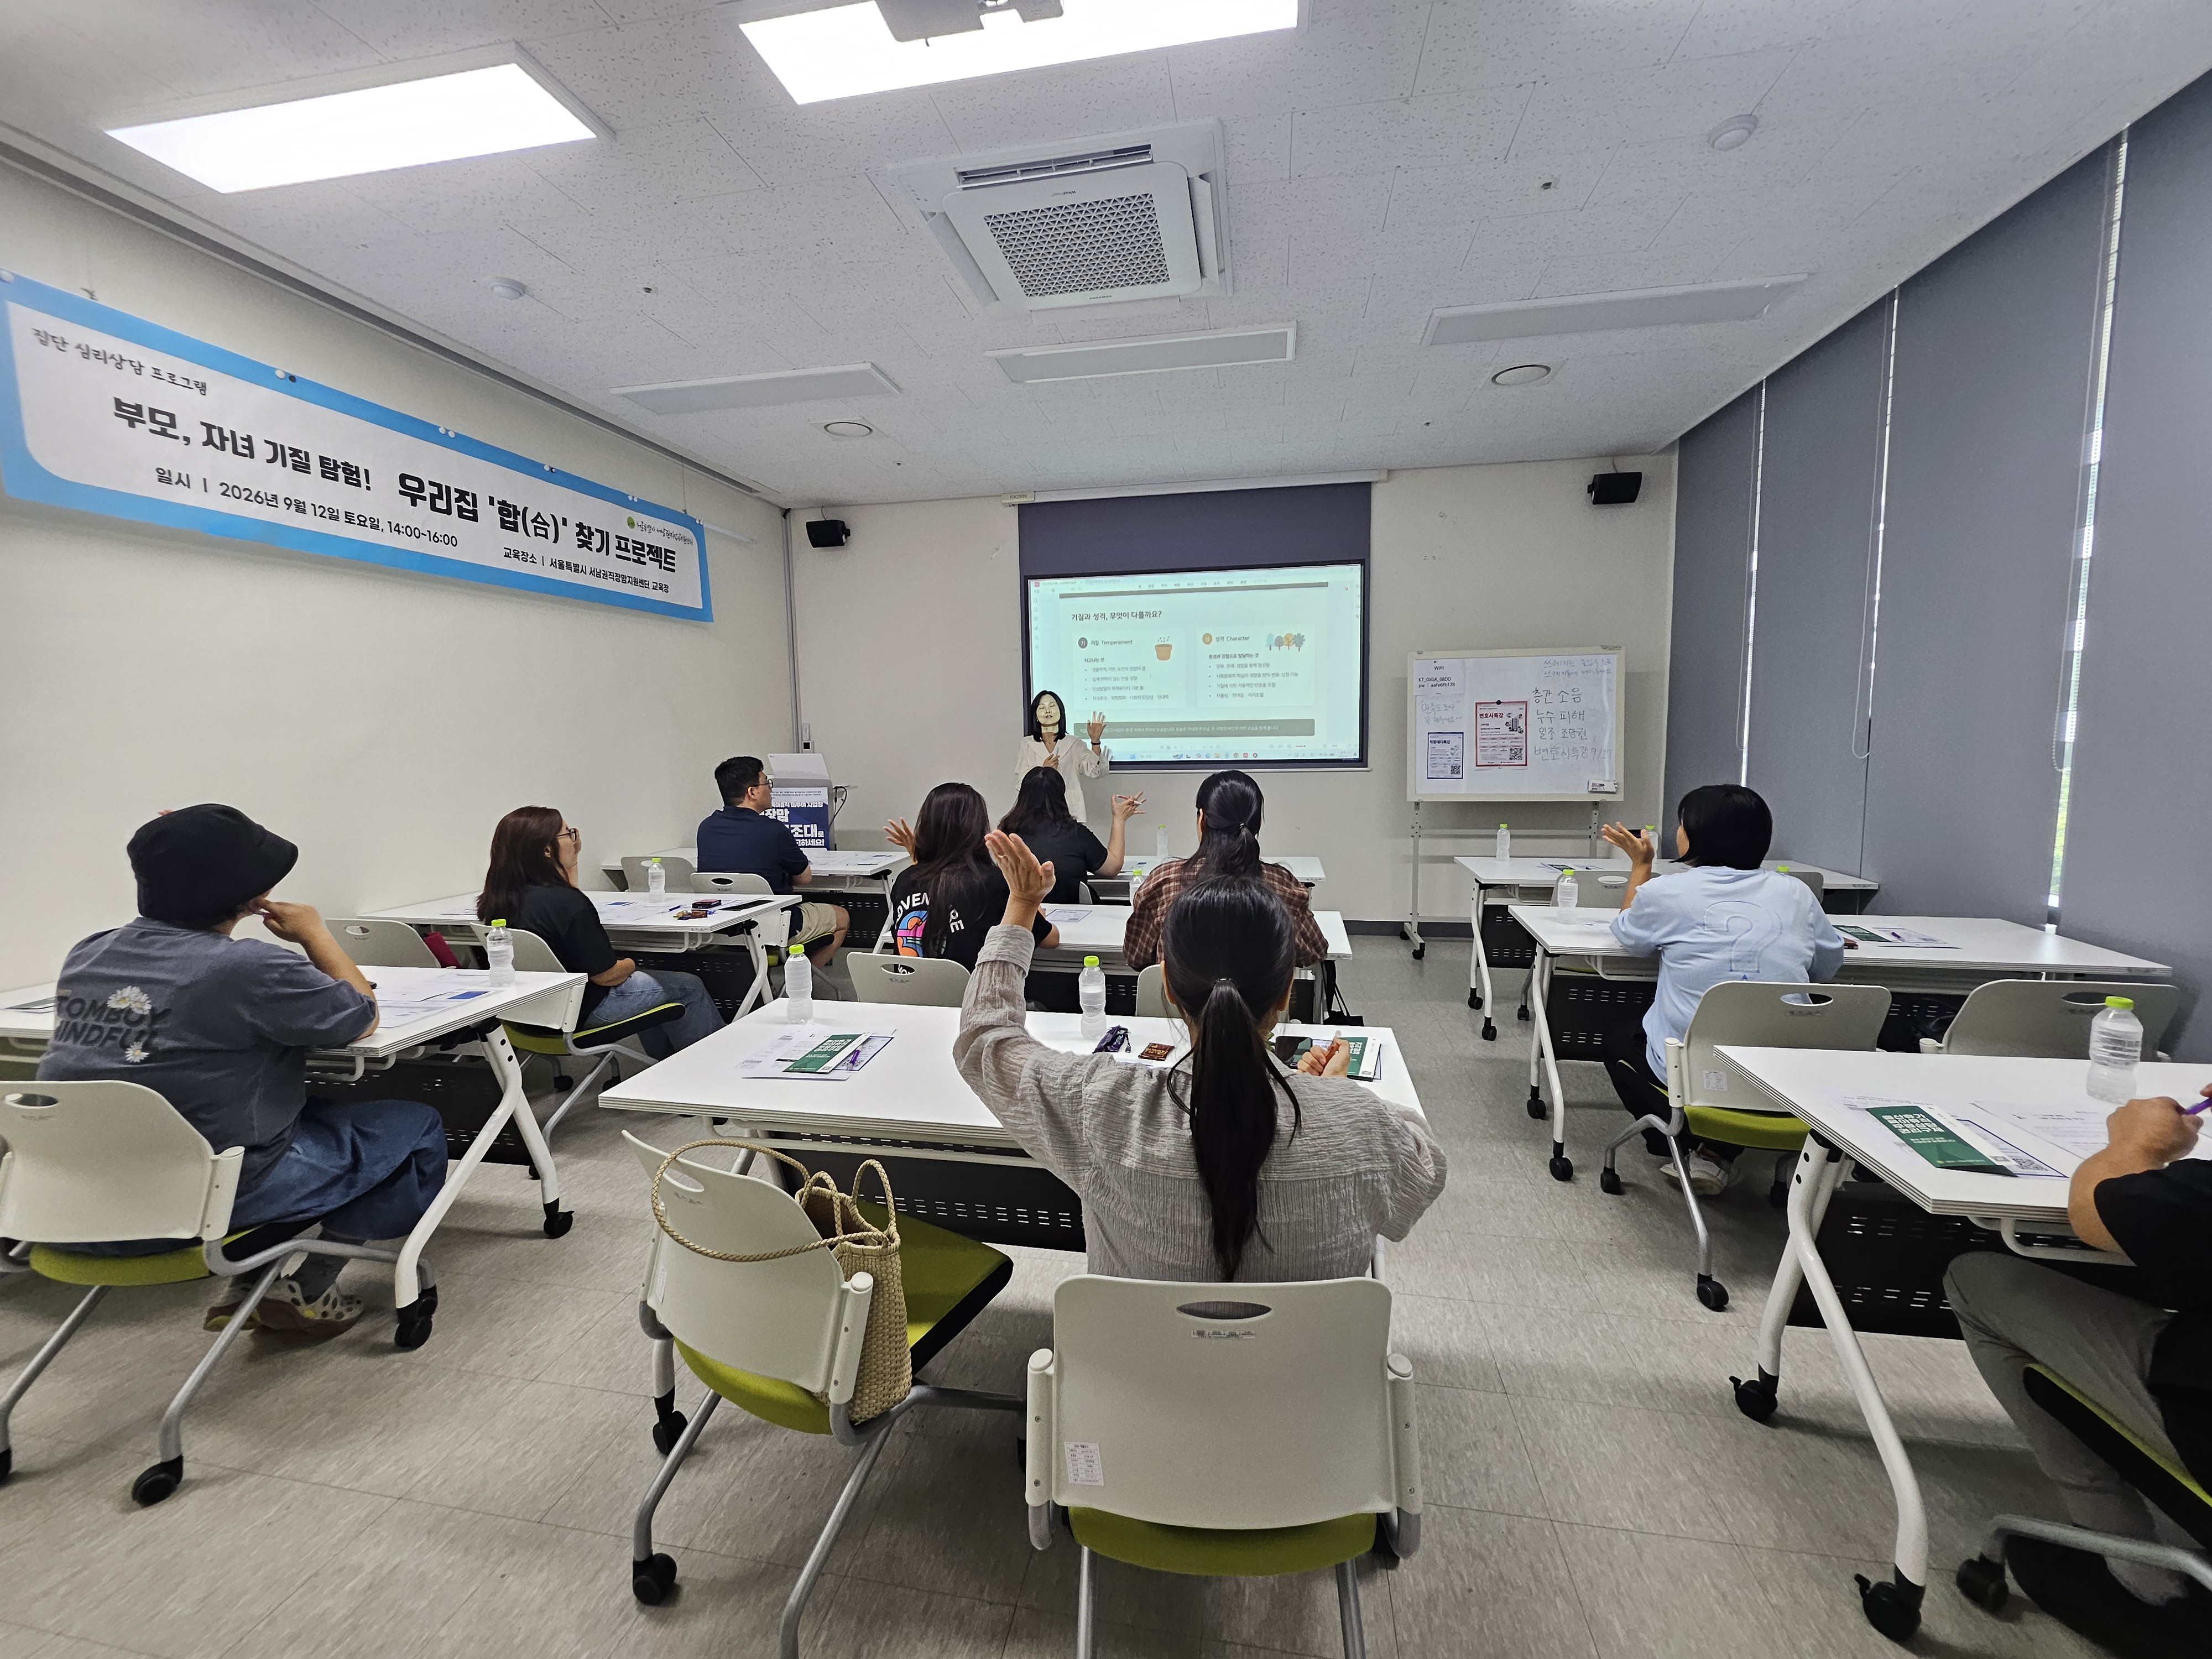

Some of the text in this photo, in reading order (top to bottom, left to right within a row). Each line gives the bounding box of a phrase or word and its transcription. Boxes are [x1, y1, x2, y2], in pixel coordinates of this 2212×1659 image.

[32, 327, 207, 396] 집단 심리상담 프로그램
[113, 396, 191, 446] 부모,
[200, 420, 255, 460] 자녀
[264, 439, 311, 474] 기질
[319, 455, 372, 491] 탐험!
[398, 472, 479, 523] 우리집
[575, 521, 609, 556] 찾기
[615, 533, 676, 573] 프로젝트
[155, 467, 191, 490] 일시
[220, 483, 279, 509] 2026년
[283, 497, 307, 515] 9월
[311, 503, 340, 523] 12일
[344, 511, 385, 533] 토요일,
[503, 547, 537, 564] 교육장소
[550, 557, 587, 575] 서울특별시
[589, 567, 650, 589] 서남권직장맘지원센터
[652, 581, 669, 593] 교육장
[1093, 613, 1108, 621] 성격,
[1131, 611, 1162, 619] 다를까요?
[1558, 687, 1581, 703] 소음
[1536, 709, 1584, 724] 누수 피해
[1534, 745, 1588, 761] 변호사특강
[759, 808, 789, 822] 장맘
[785, 824, 825, 837] 조대로
